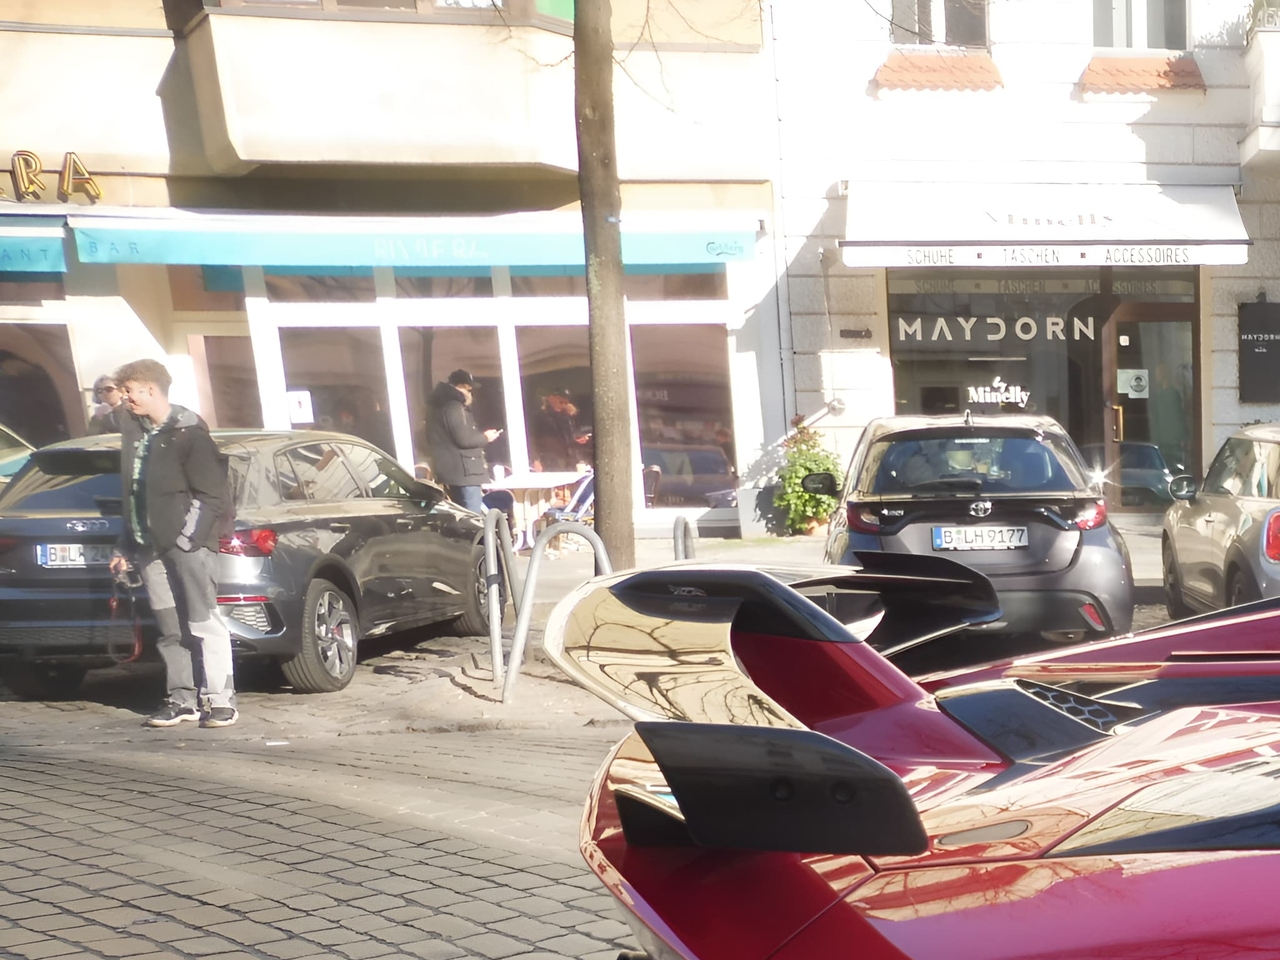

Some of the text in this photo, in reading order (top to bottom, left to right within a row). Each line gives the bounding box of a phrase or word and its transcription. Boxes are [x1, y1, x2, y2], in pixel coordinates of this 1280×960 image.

[89, 241, 139, 255] BAR
[907, 247, 1190, 265] SCHUHE TASCHEN ACCESSOIRES
[898, 316, 1095, 341] MAYDORN
[967, 386, 1030, 408] Minelly
[944, 530, 954, 544] B
[987, 528, 1025, 544] 9177
